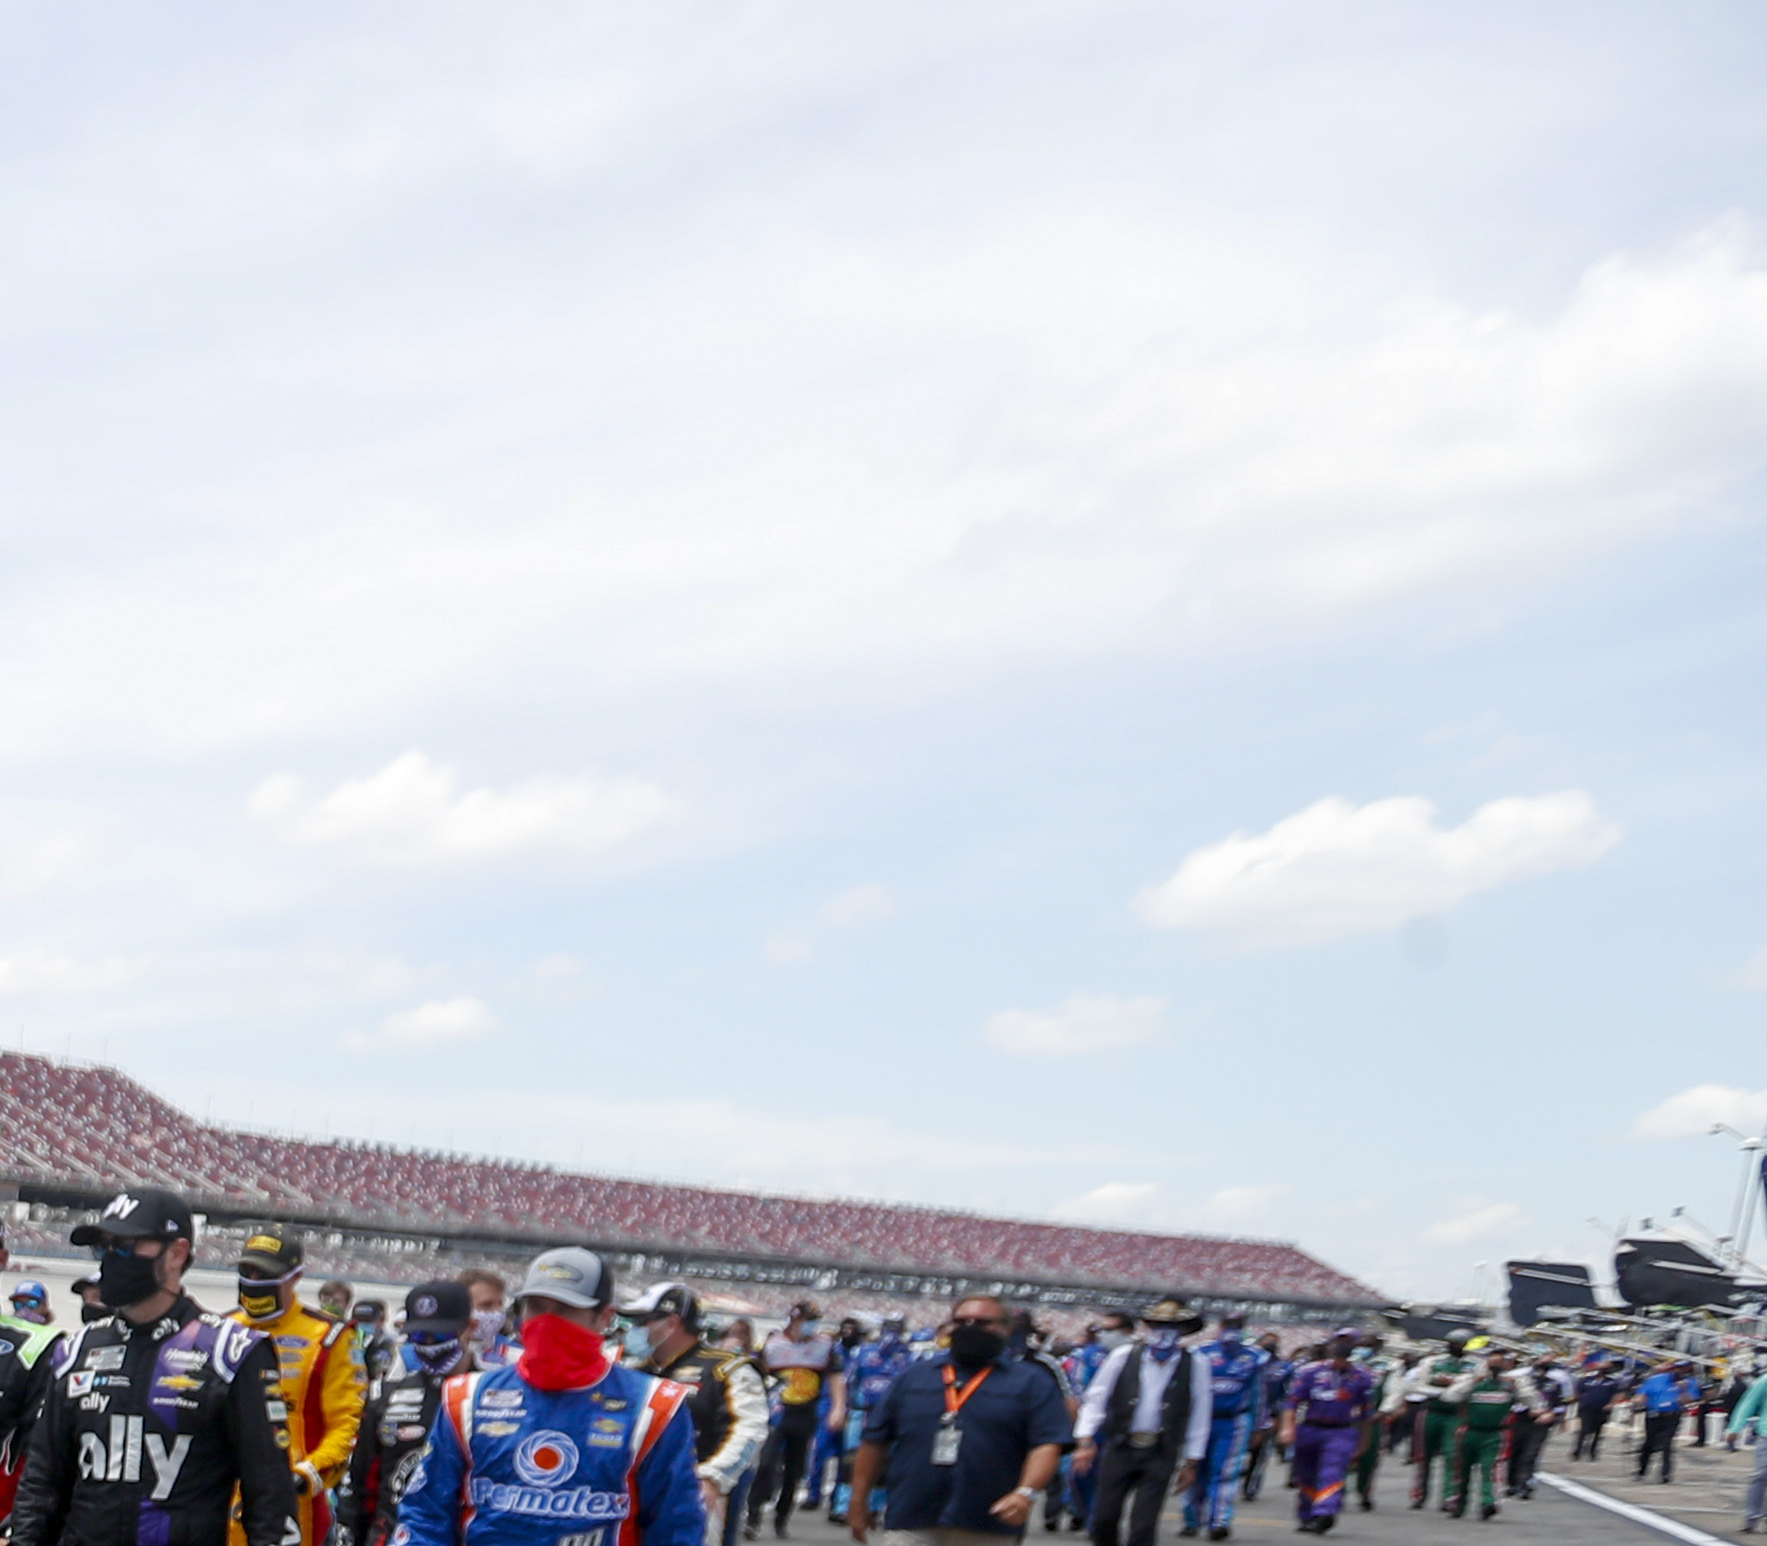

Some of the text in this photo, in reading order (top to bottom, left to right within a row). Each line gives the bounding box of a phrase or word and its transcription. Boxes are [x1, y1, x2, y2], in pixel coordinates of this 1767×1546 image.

[79, 1392, 111, 1414] ally
[77, 1413, 194, 1500] ally
[472, 1476, 631, 1520] Permatex
